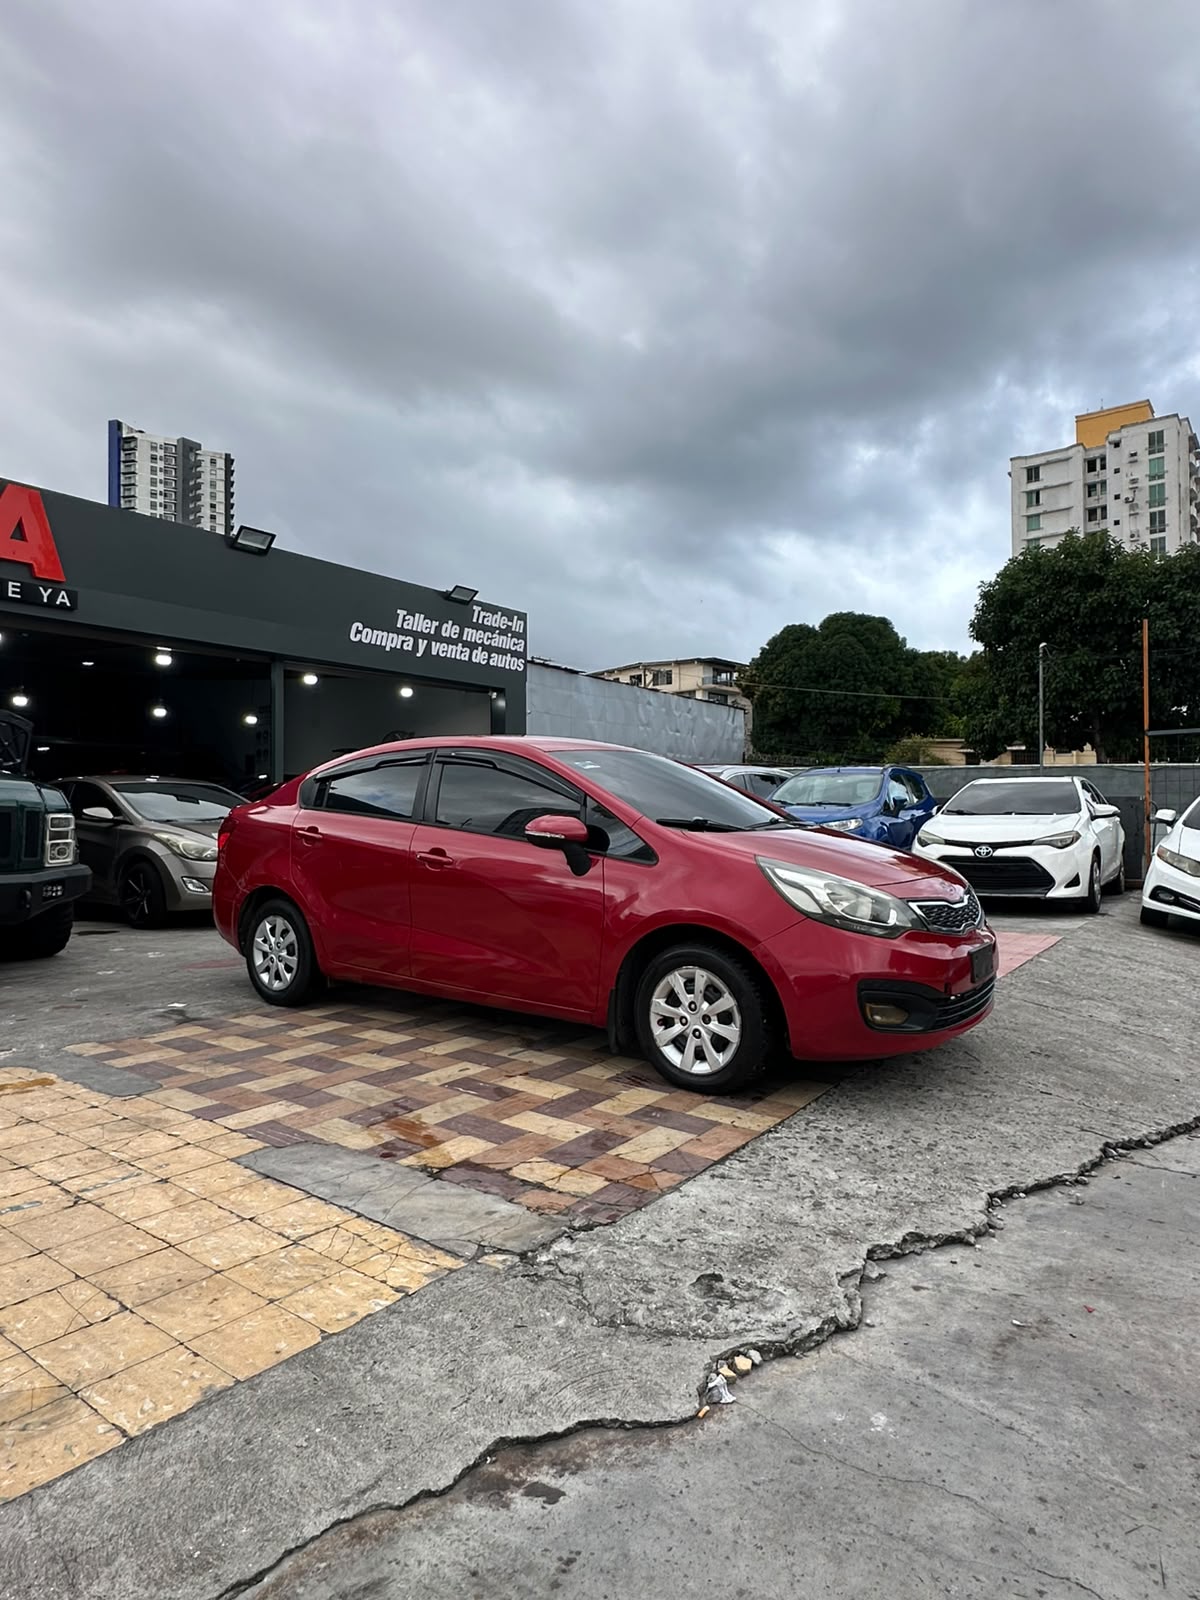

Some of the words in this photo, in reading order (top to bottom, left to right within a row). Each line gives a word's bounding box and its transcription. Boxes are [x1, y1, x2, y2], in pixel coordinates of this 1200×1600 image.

[39, 586, 71, 607] YA
[396, 609, 439, 635] Taller
[441, 620, 460, 639] de
[463, 627, 525, 652] mecánica
[472, 605, 524, 633] Trade-In
[350, 622, 414, 651] Compra
[416, 638, 428, 657] y
[431, 641, 469, 661] venta
[471, 646, 488, 665] de
[489, 652, 525, 672] autos
